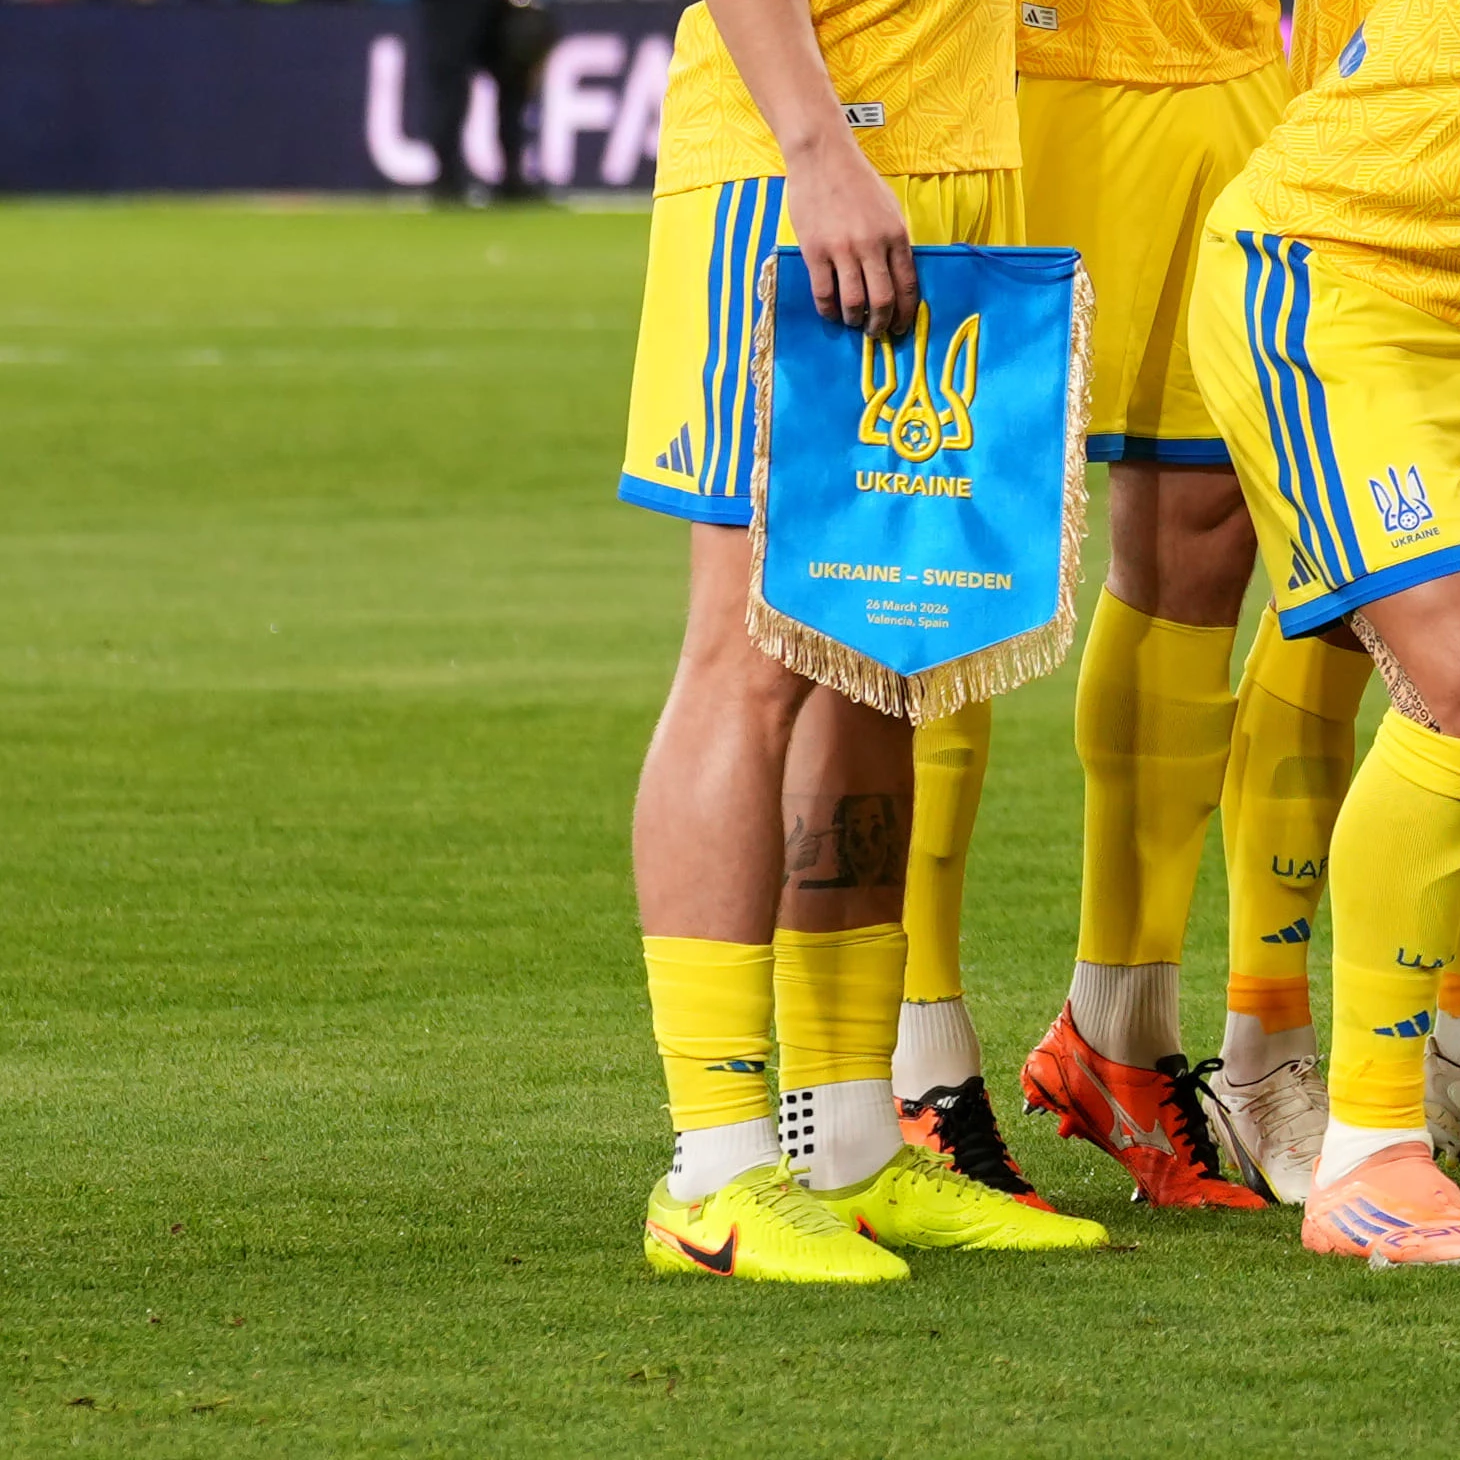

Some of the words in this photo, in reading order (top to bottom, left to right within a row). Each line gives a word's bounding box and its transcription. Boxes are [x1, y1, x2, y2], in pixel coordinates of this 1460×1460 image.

[856, 471, 973, 498] UKRAINE
[1390, 526, 1441, 549] UKRAINE
[808, 561, 902, 583] UKRAINE
[922, 568, 1012, 590] SWEDEN
[866, 599, 880, 611] 26
[882, 600, 917, 612] March
[919, 602, 949, 614] 2026
[866, 613, 916, 628] Valencia,
[918, 616, 949, 629] Spain
